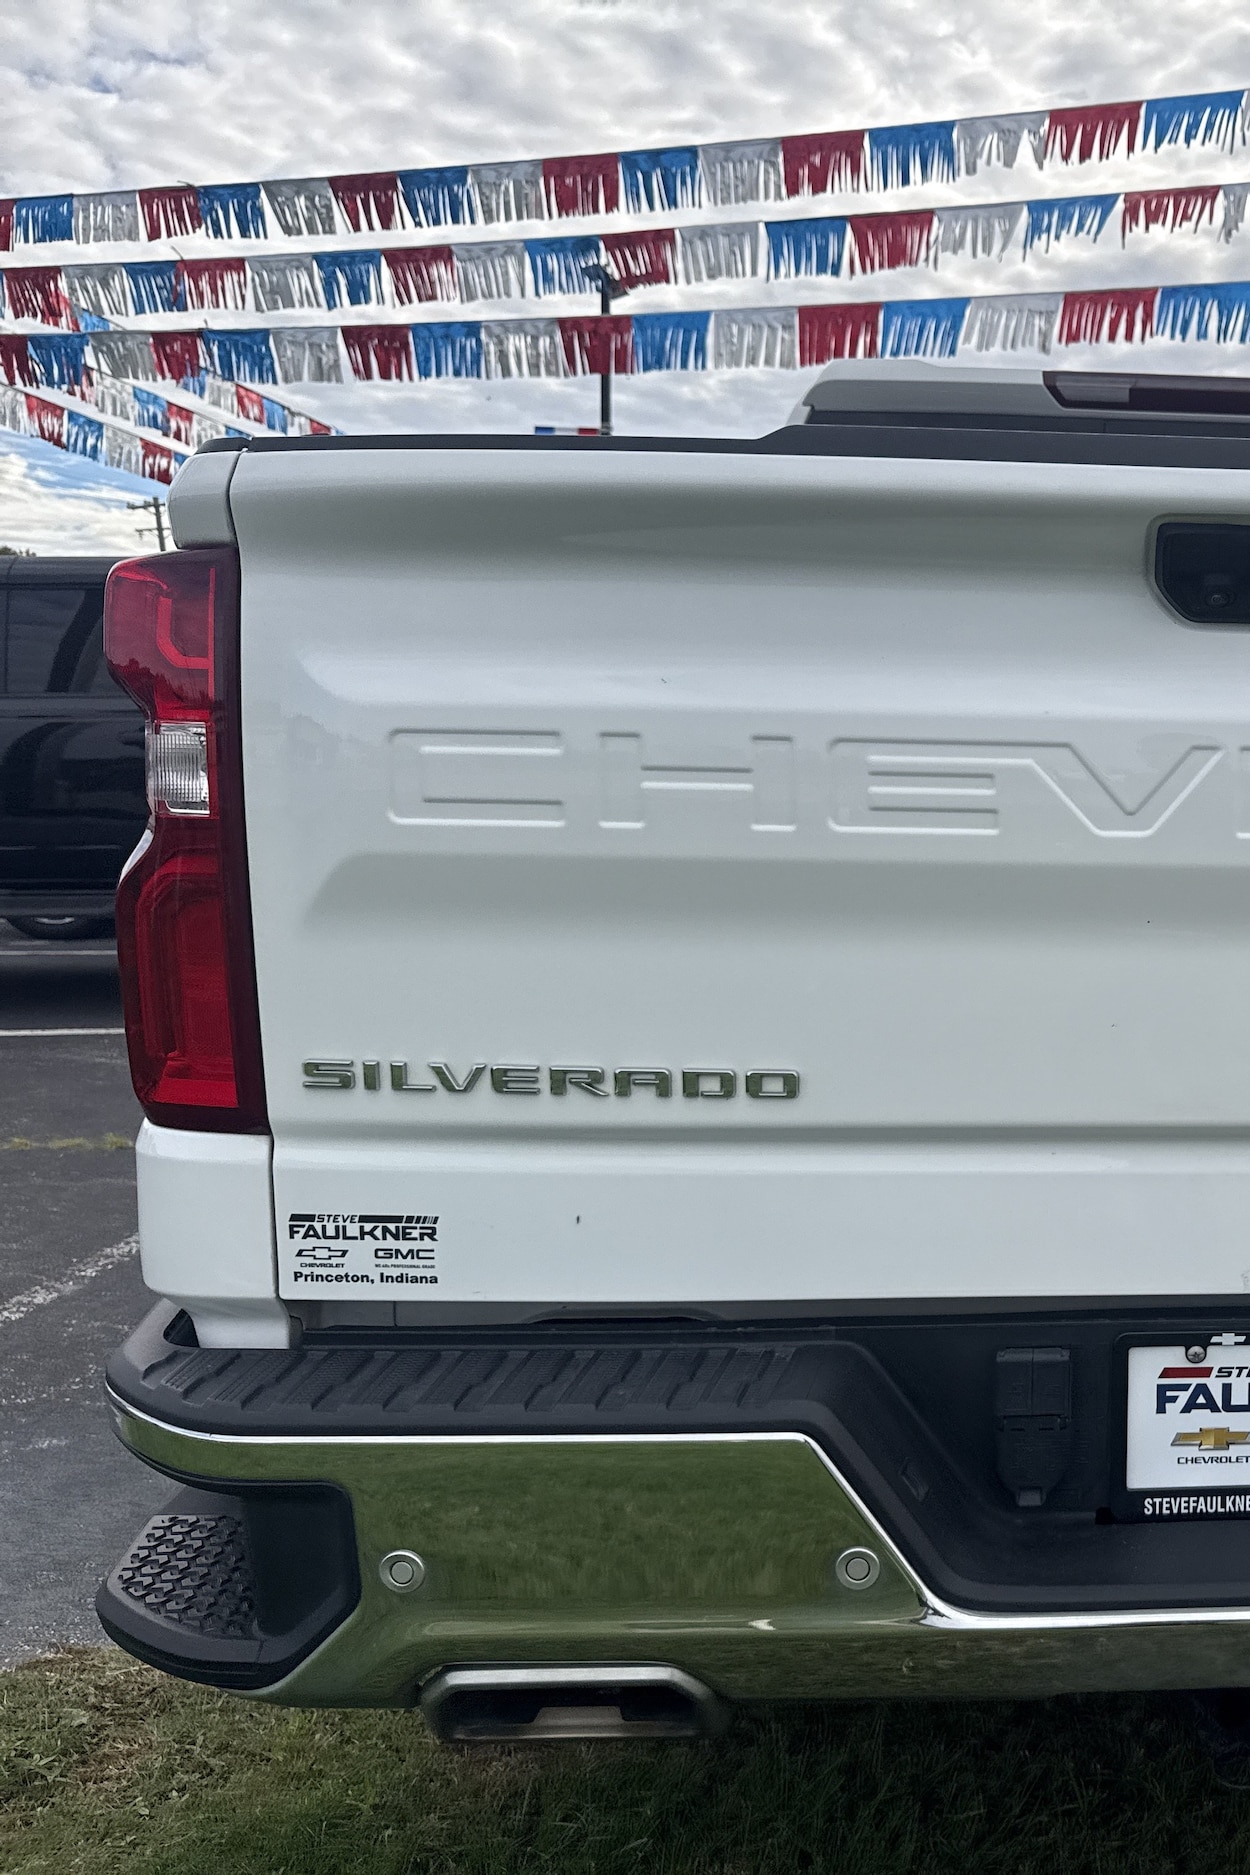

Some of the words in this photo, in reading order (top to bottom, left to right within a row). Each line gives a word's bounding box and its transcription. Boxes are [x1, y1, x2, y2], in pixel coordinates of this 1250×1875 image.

[302, 1057, 800, 1099] SILVERADO
[316, 1213, 358, 1224] STEVE
[288, 1224, 439, 1242] FAULKNER
[374, 1248, 436, 1260] GMC
[293, 1271, 375, 1285] Princeton,
[380, 1272, 439, 1284] Indiana
